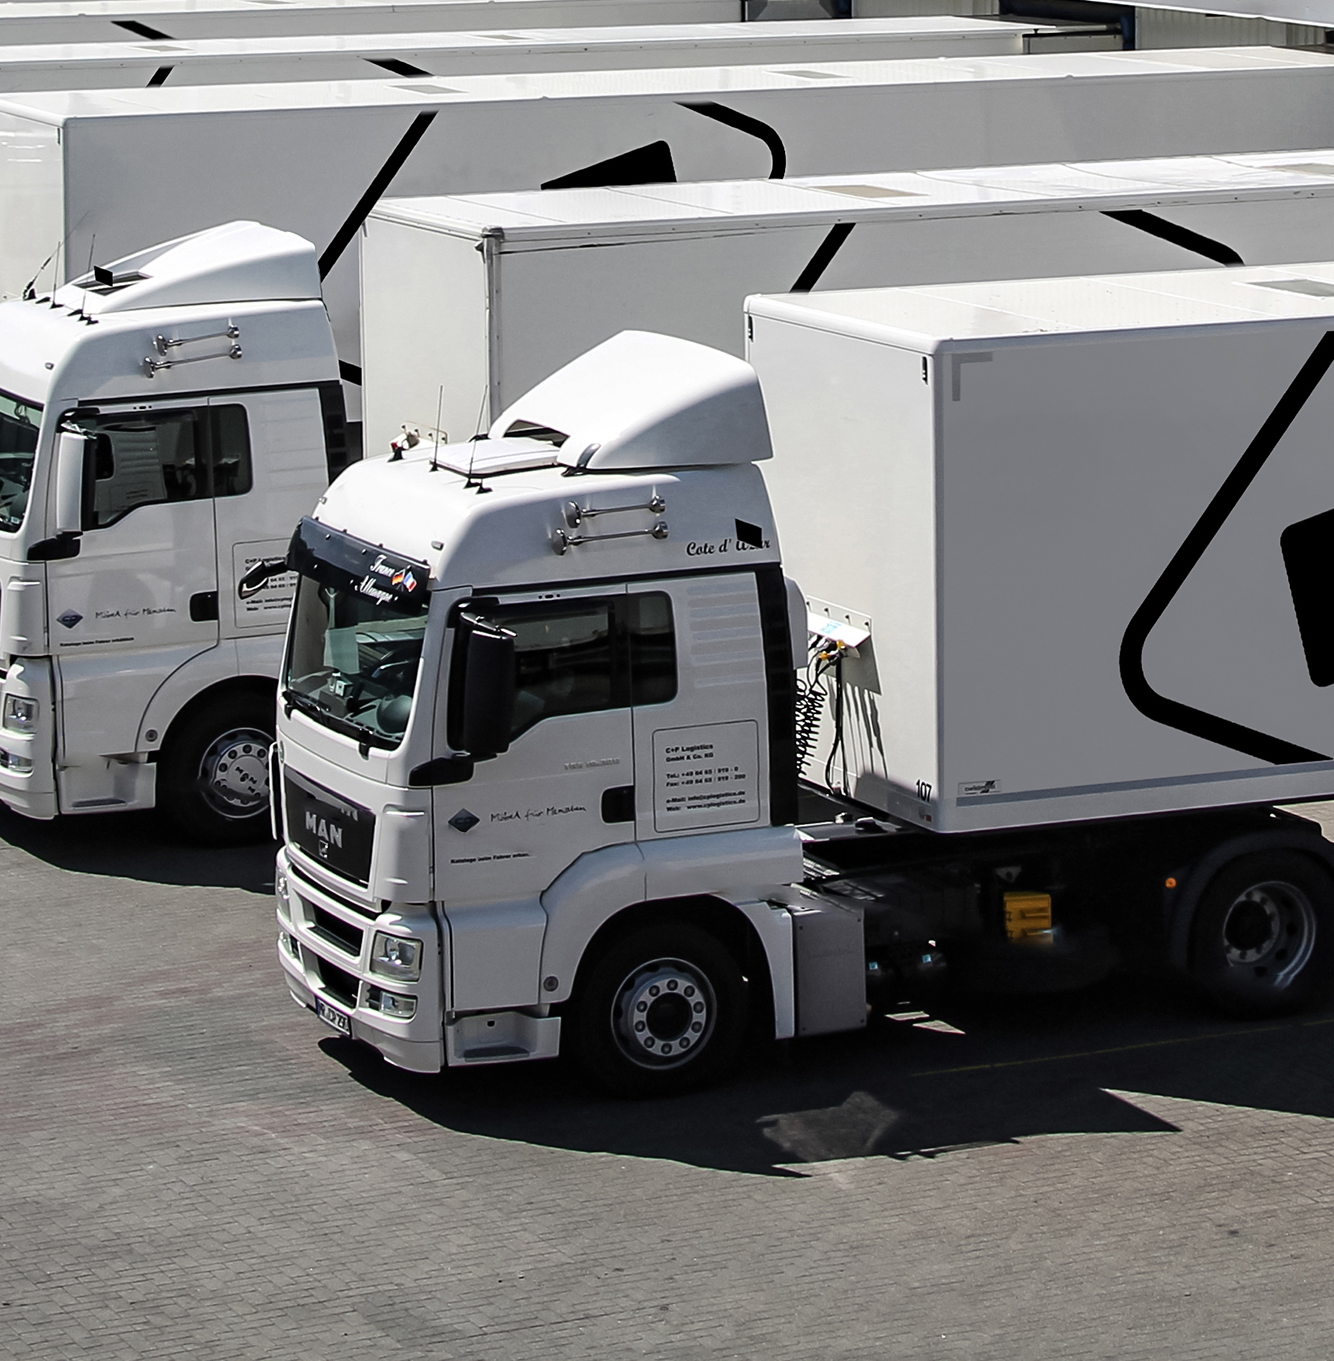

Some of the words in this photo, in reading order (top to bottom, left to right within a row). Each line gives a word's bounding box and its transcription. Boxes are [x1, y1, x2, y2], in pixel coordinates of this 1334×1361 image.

[686, 541, 715, 557] Cote
[681, 744, 713, 752] Logistics
[915, 779, 933, 802] 107
[305, 811, 343, 849] MAN
